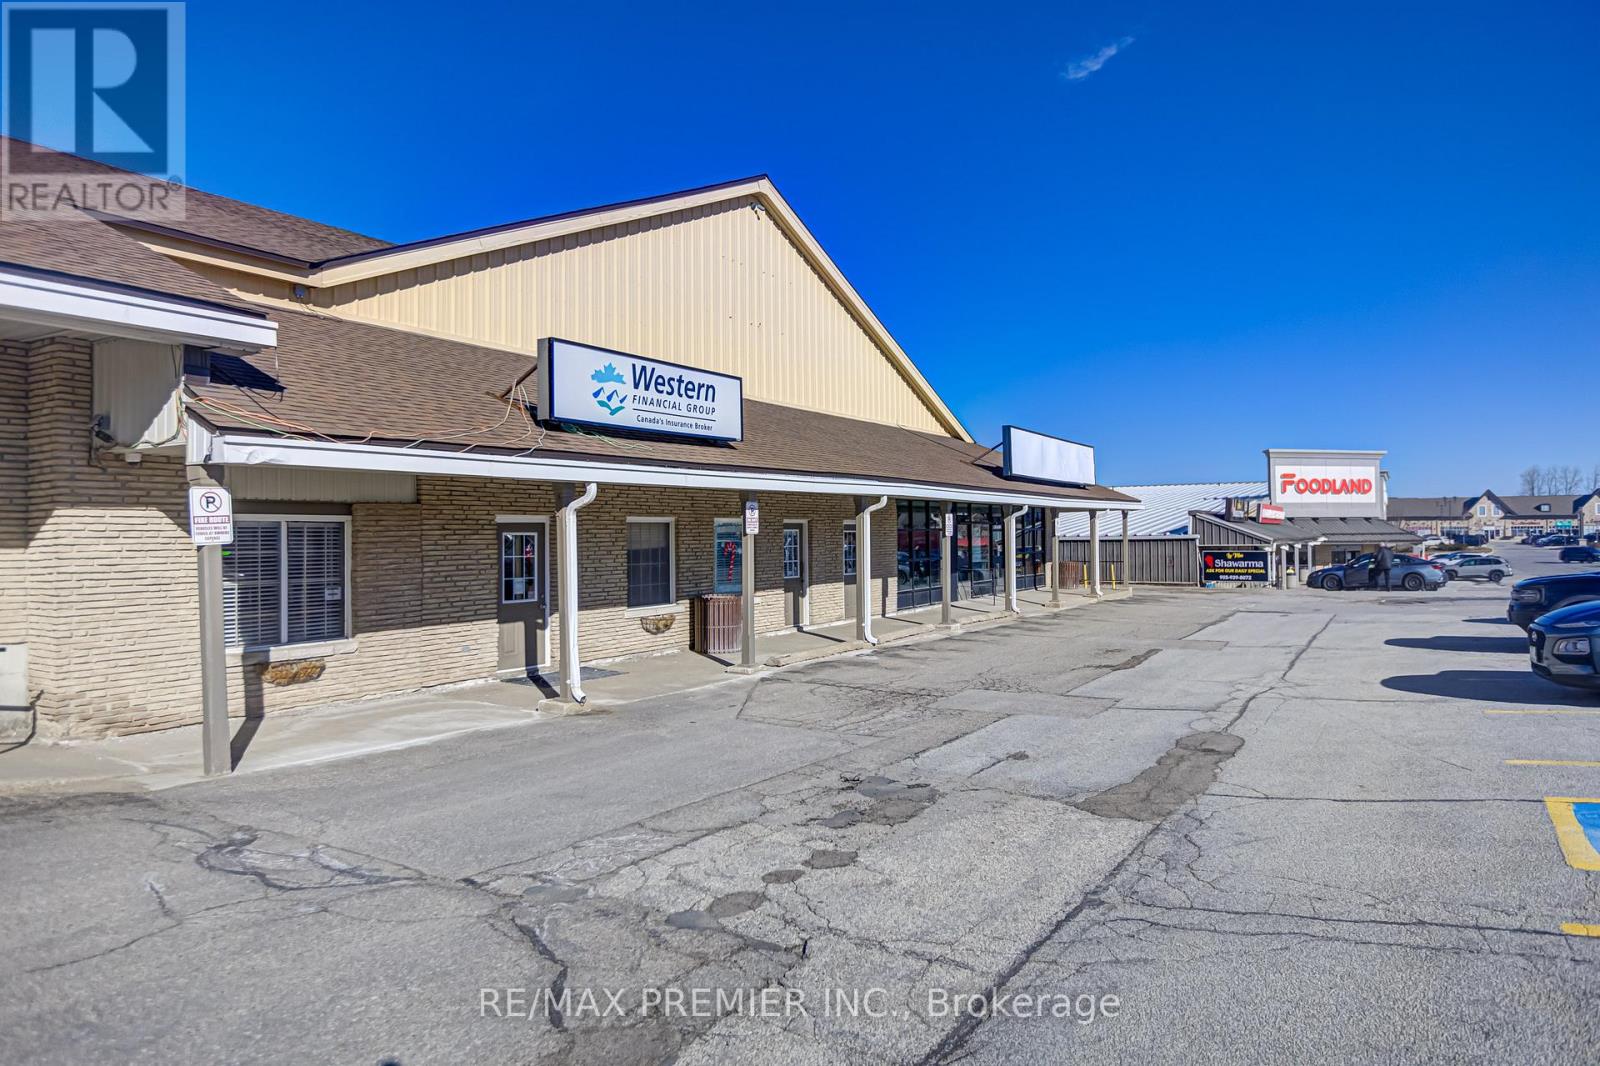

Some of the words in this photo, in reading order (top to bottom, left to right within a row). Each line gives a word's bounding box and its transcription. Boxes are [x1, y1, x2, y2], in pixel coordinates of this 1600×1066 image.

[632, 363, 716, 403] Western
[632, 395, 682, 411] FINANCIAL
[686, 403, 716, 416] GROUP
[636, 415, 664, 425] Canada's
[665, 419, 693, 429] Insurance
[694, 422, 713, 431] Broker
[1280, 473, 1372, 495] FOODLAND
[1214, 559, 1264, 568] Shawarma
